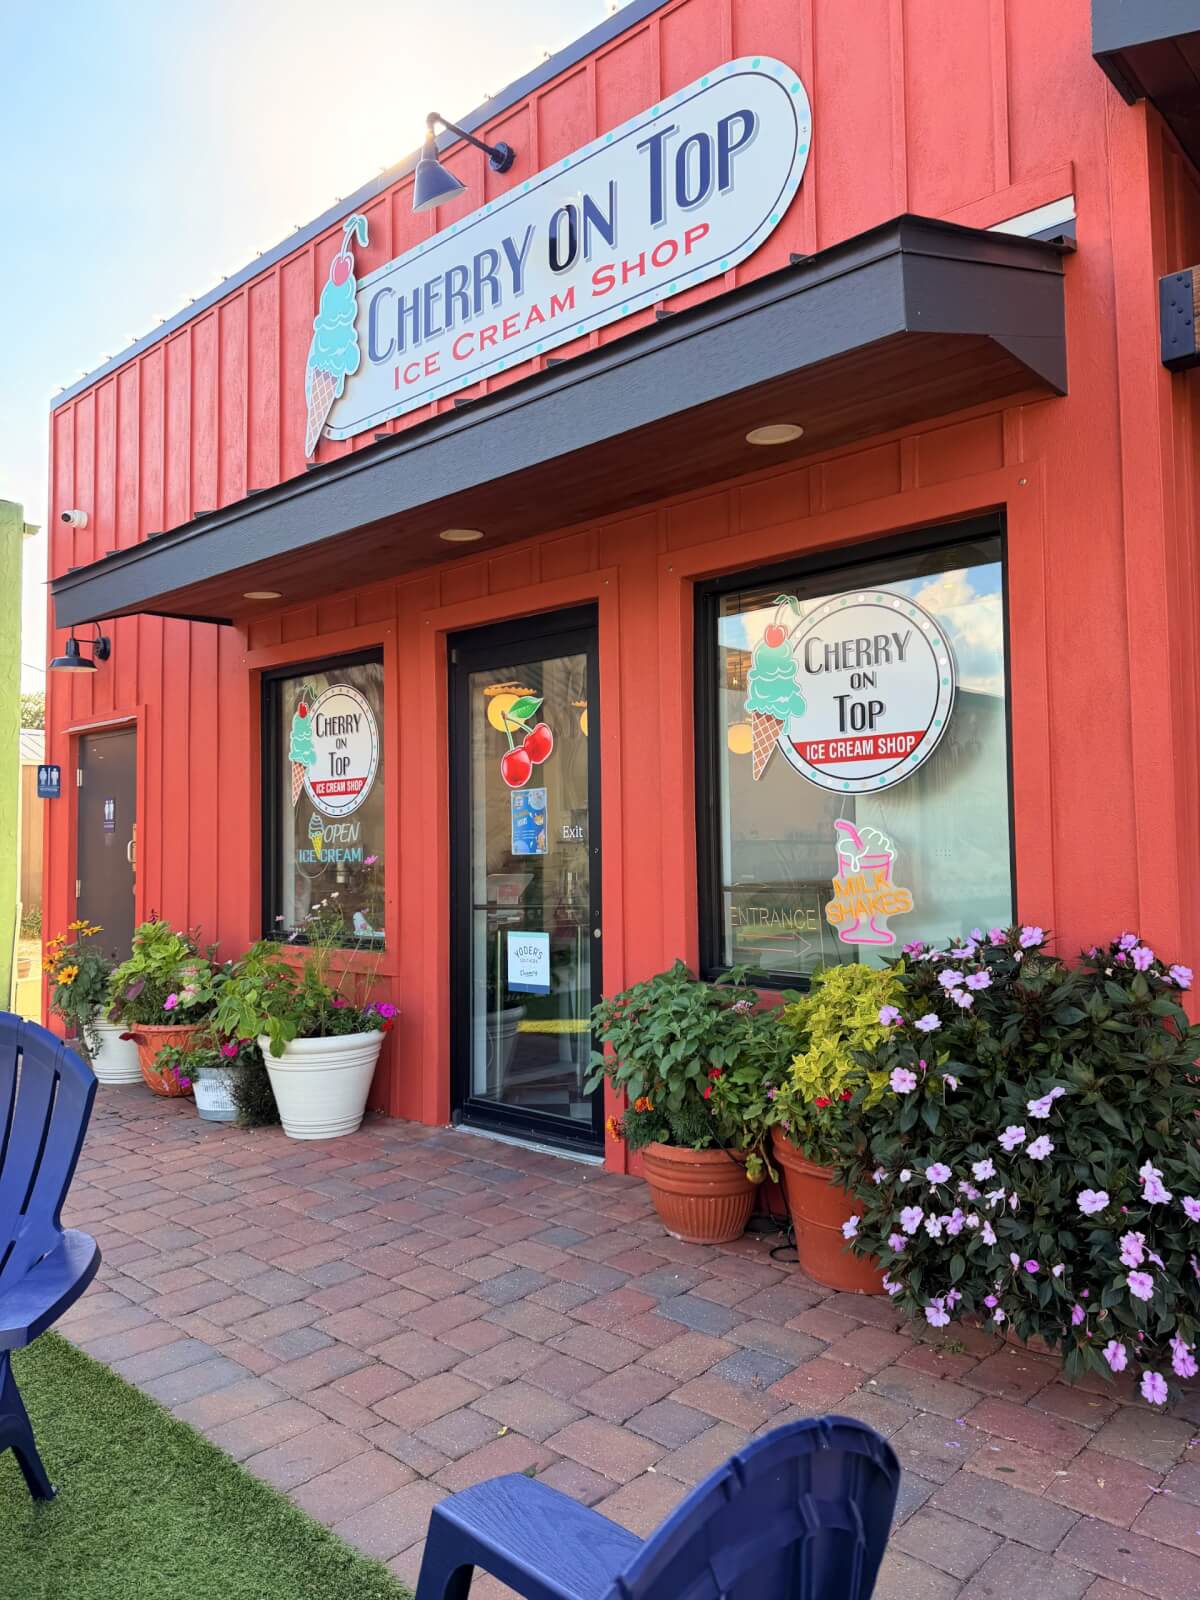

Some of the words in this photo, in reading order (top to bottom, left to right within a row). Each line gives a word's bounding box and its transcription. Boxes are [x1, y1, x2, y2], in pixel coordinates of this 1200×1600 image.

[368, 224, 536, 365] CHERRY
[549, 179, 617, 275] ON
[636, 109, 760, 231] TOP
[394, 351, 441, 390] ICE
[452, 287, 576, 361] CREAM
[591, 222, 710, 297] SHOP
[804, 630, 912, 675] CHERRY
[850, 671, 877, 690] ON
[316, 712, 362, 738] CHERRY
[833, 694, 886, 734] TOP
[335, 738, 348, 750] ON
[806, 744, 825, 760] ICE
[829, 739, 874, 758] CREAM
[878, 735, 915, 754] SHOP
[328, 752, 351, 777] TOP
[316, 783, 325, 794] ICE
[326, 781, 346, 792] CREAM
[347, 780, 363, 791] SHOP
[323, 821, 360, 843] OPEN
[563, 825, 584, 839] Exit
[299, 849, 317, 863] ICE
[319, 848, 363, 863] CREAM
[833, 871, 890, 898] MILK
[729, 906, 817, 930] ENTRANCE
[828, 891, 911, 925] SHAKES
